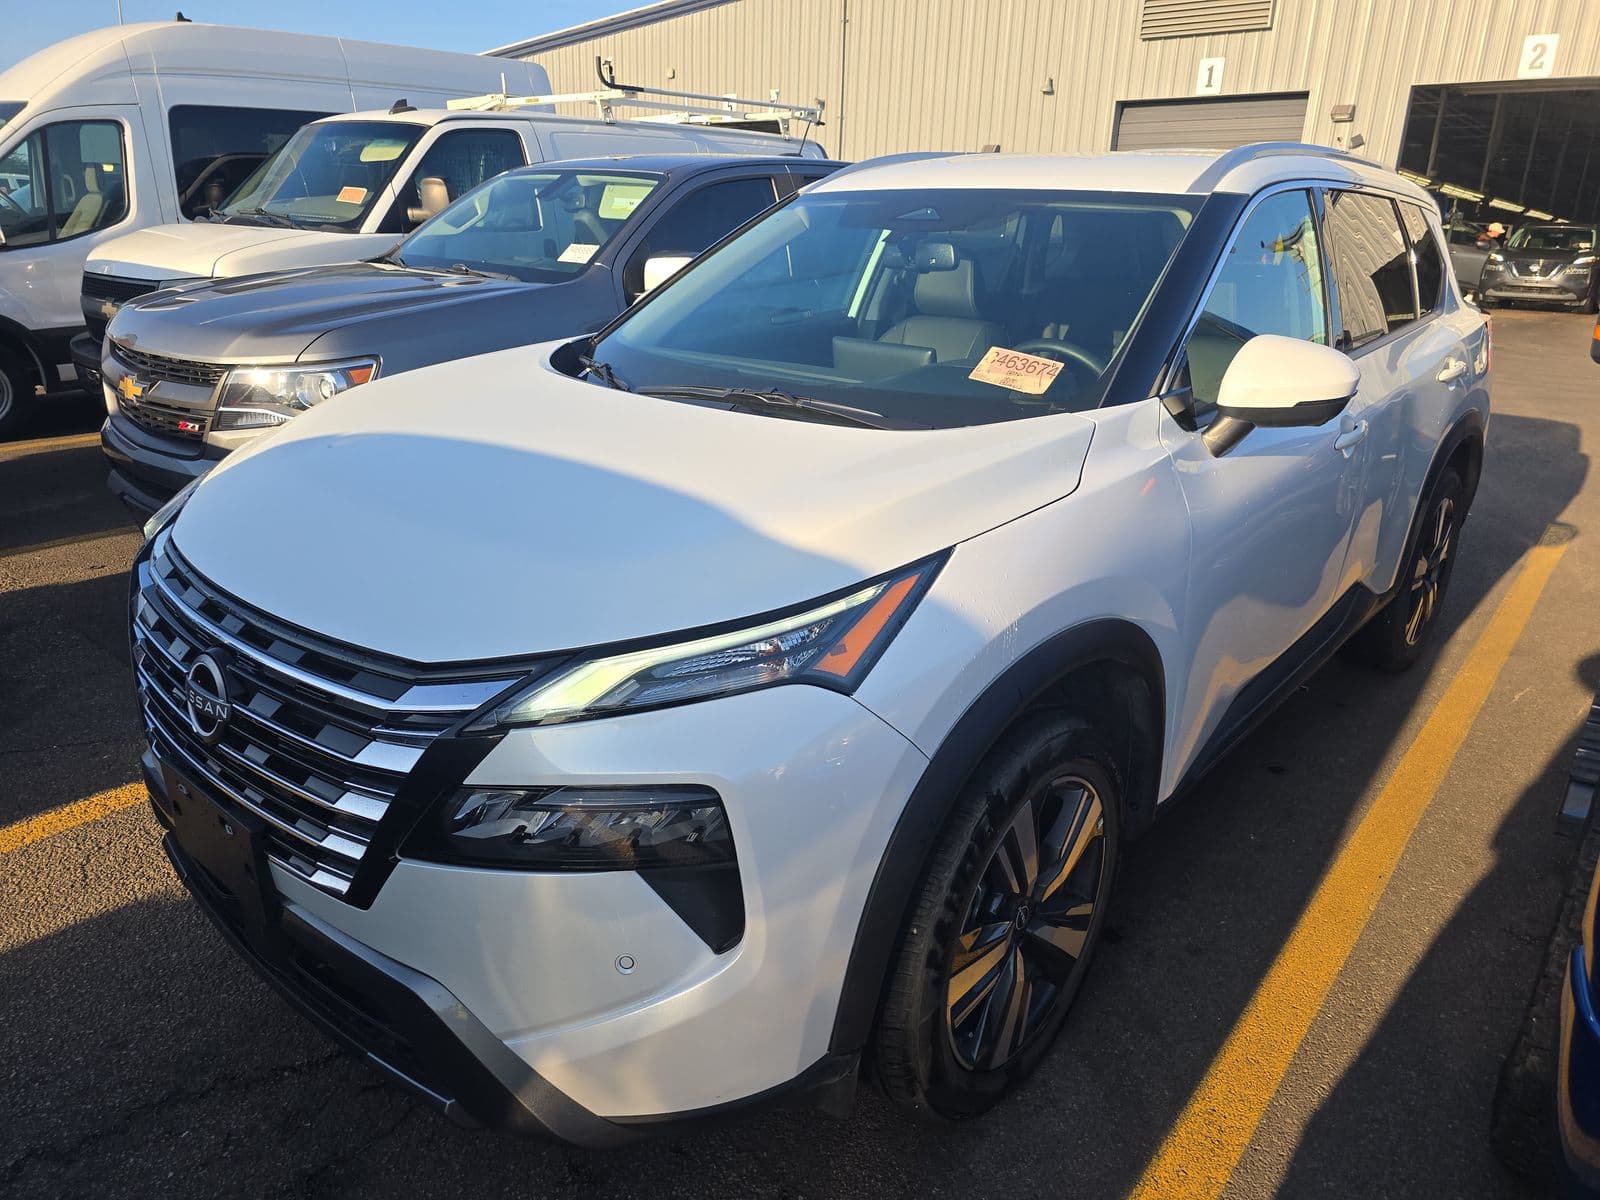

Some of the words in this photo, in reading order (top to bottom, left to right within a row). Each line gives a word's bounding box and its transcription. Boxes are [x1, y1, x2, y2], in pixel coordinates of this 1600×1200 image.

[1528, 43, 1547, 70] 2
[1205, 65, 1214, 88] 1
[177, 421, 199, 432] Z71
[189, 690, 228, 719] SSAN
